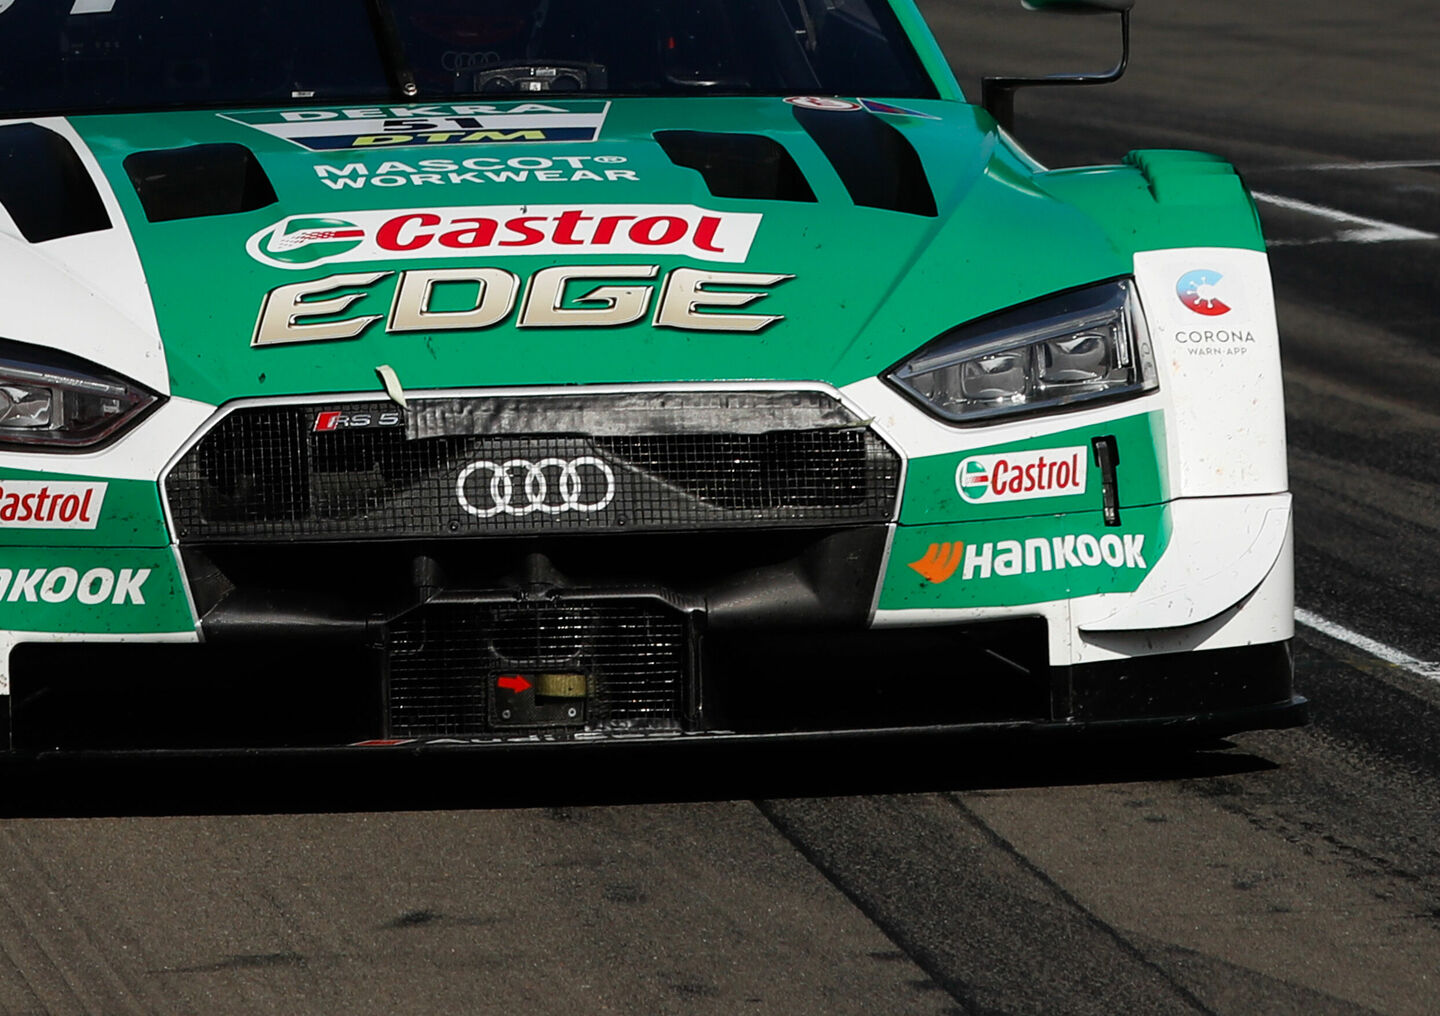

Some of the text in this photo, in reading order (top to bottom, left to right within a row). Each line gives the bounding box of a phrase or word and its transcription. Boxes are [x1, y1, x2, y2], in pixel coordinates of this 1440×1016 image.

[279, 103, 570, 122] DEKRA
[382, 117, 486, 132] 51
[351, 130, 547, 147] DTM
[320, 169, 640, 191] WORKWEAR
[375, 210, 725, 252] Castrol
[250, 264, 797, 348] EDGE
[1175, 330, 1256, 344] CORONA
[327, 412, 399, 428] RS 5
[991, 453, 1079, 496] Castrol
